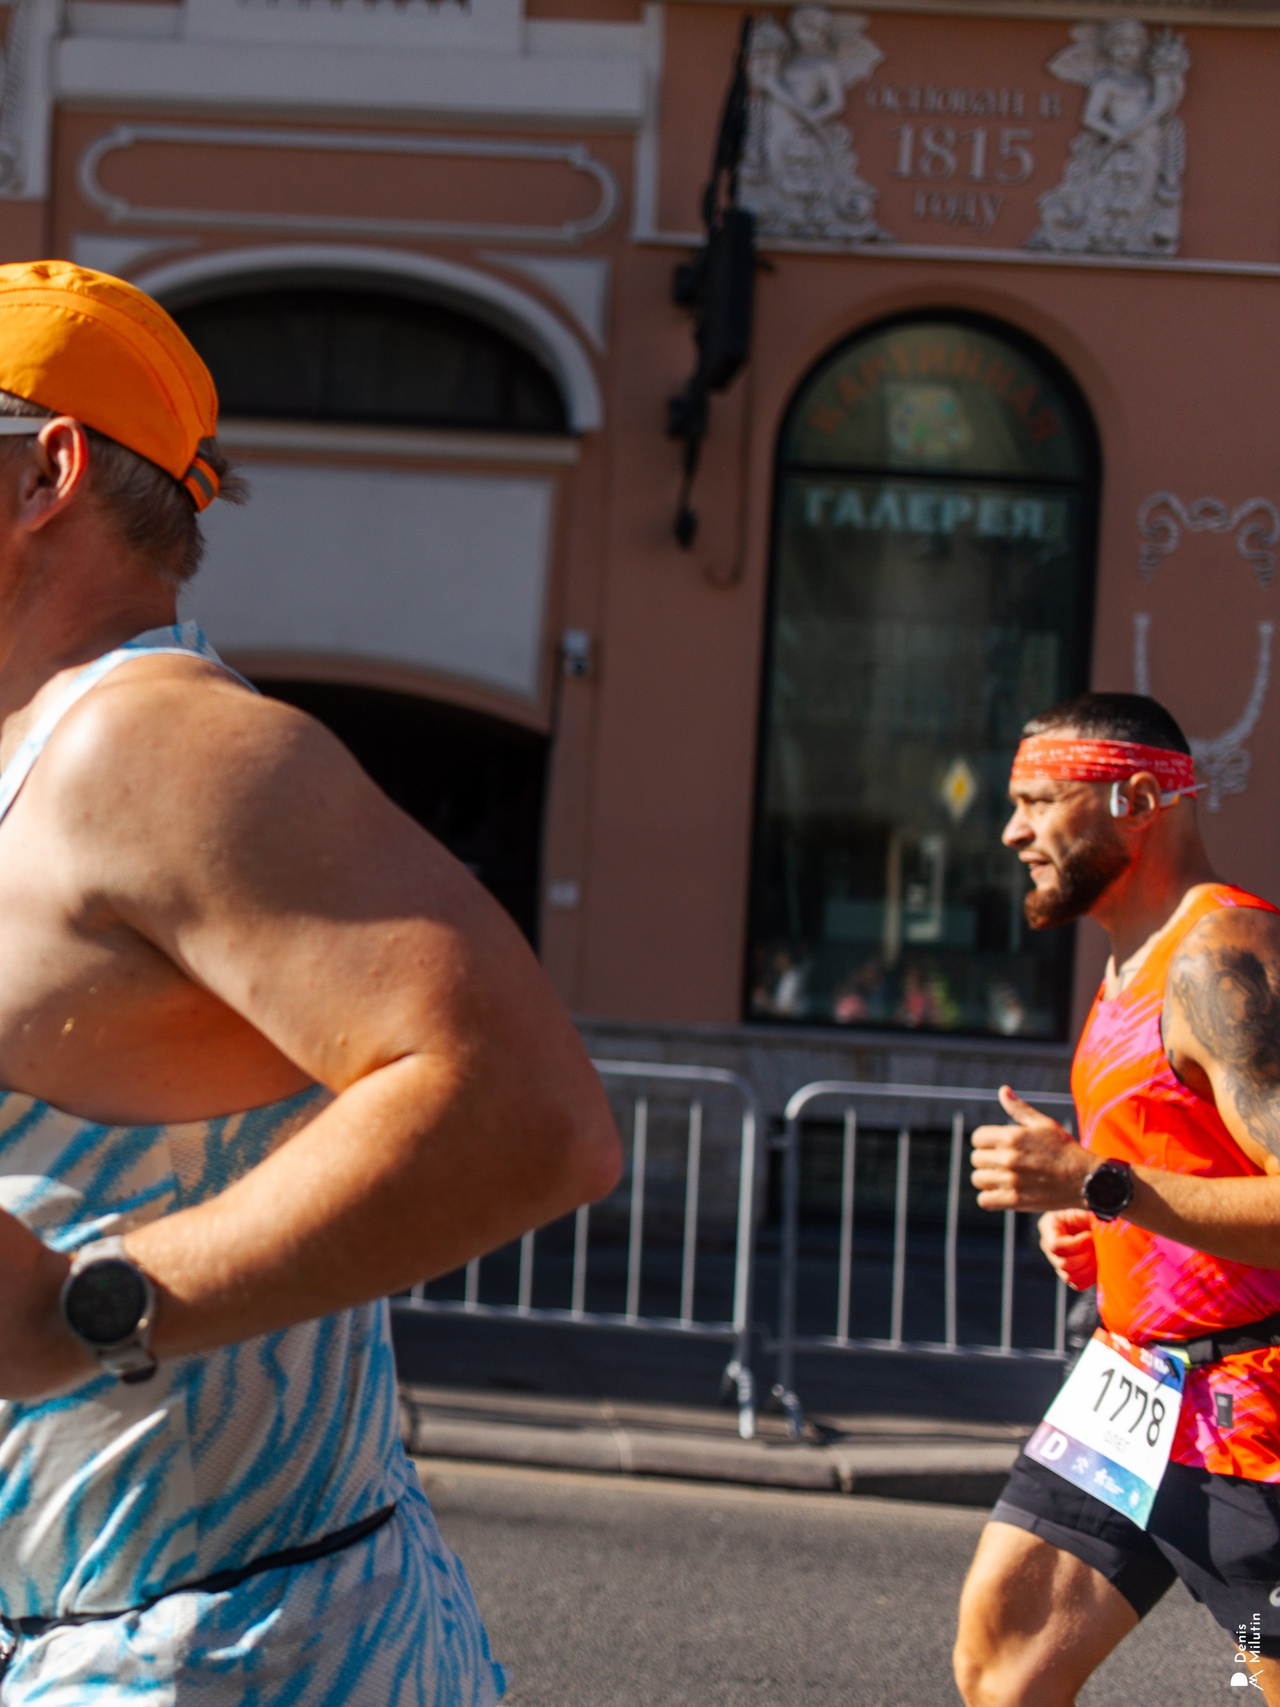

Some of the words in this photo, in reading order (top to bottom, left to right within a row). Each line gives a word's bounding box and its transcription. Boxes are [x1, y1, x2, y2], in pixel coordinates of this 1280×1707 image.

[885, 122, 1034, 185] 1815
[805, 486, 1046, 537] ГАЛЕРЕЯ
[1093, 1368, 1166, 1448] 1778
